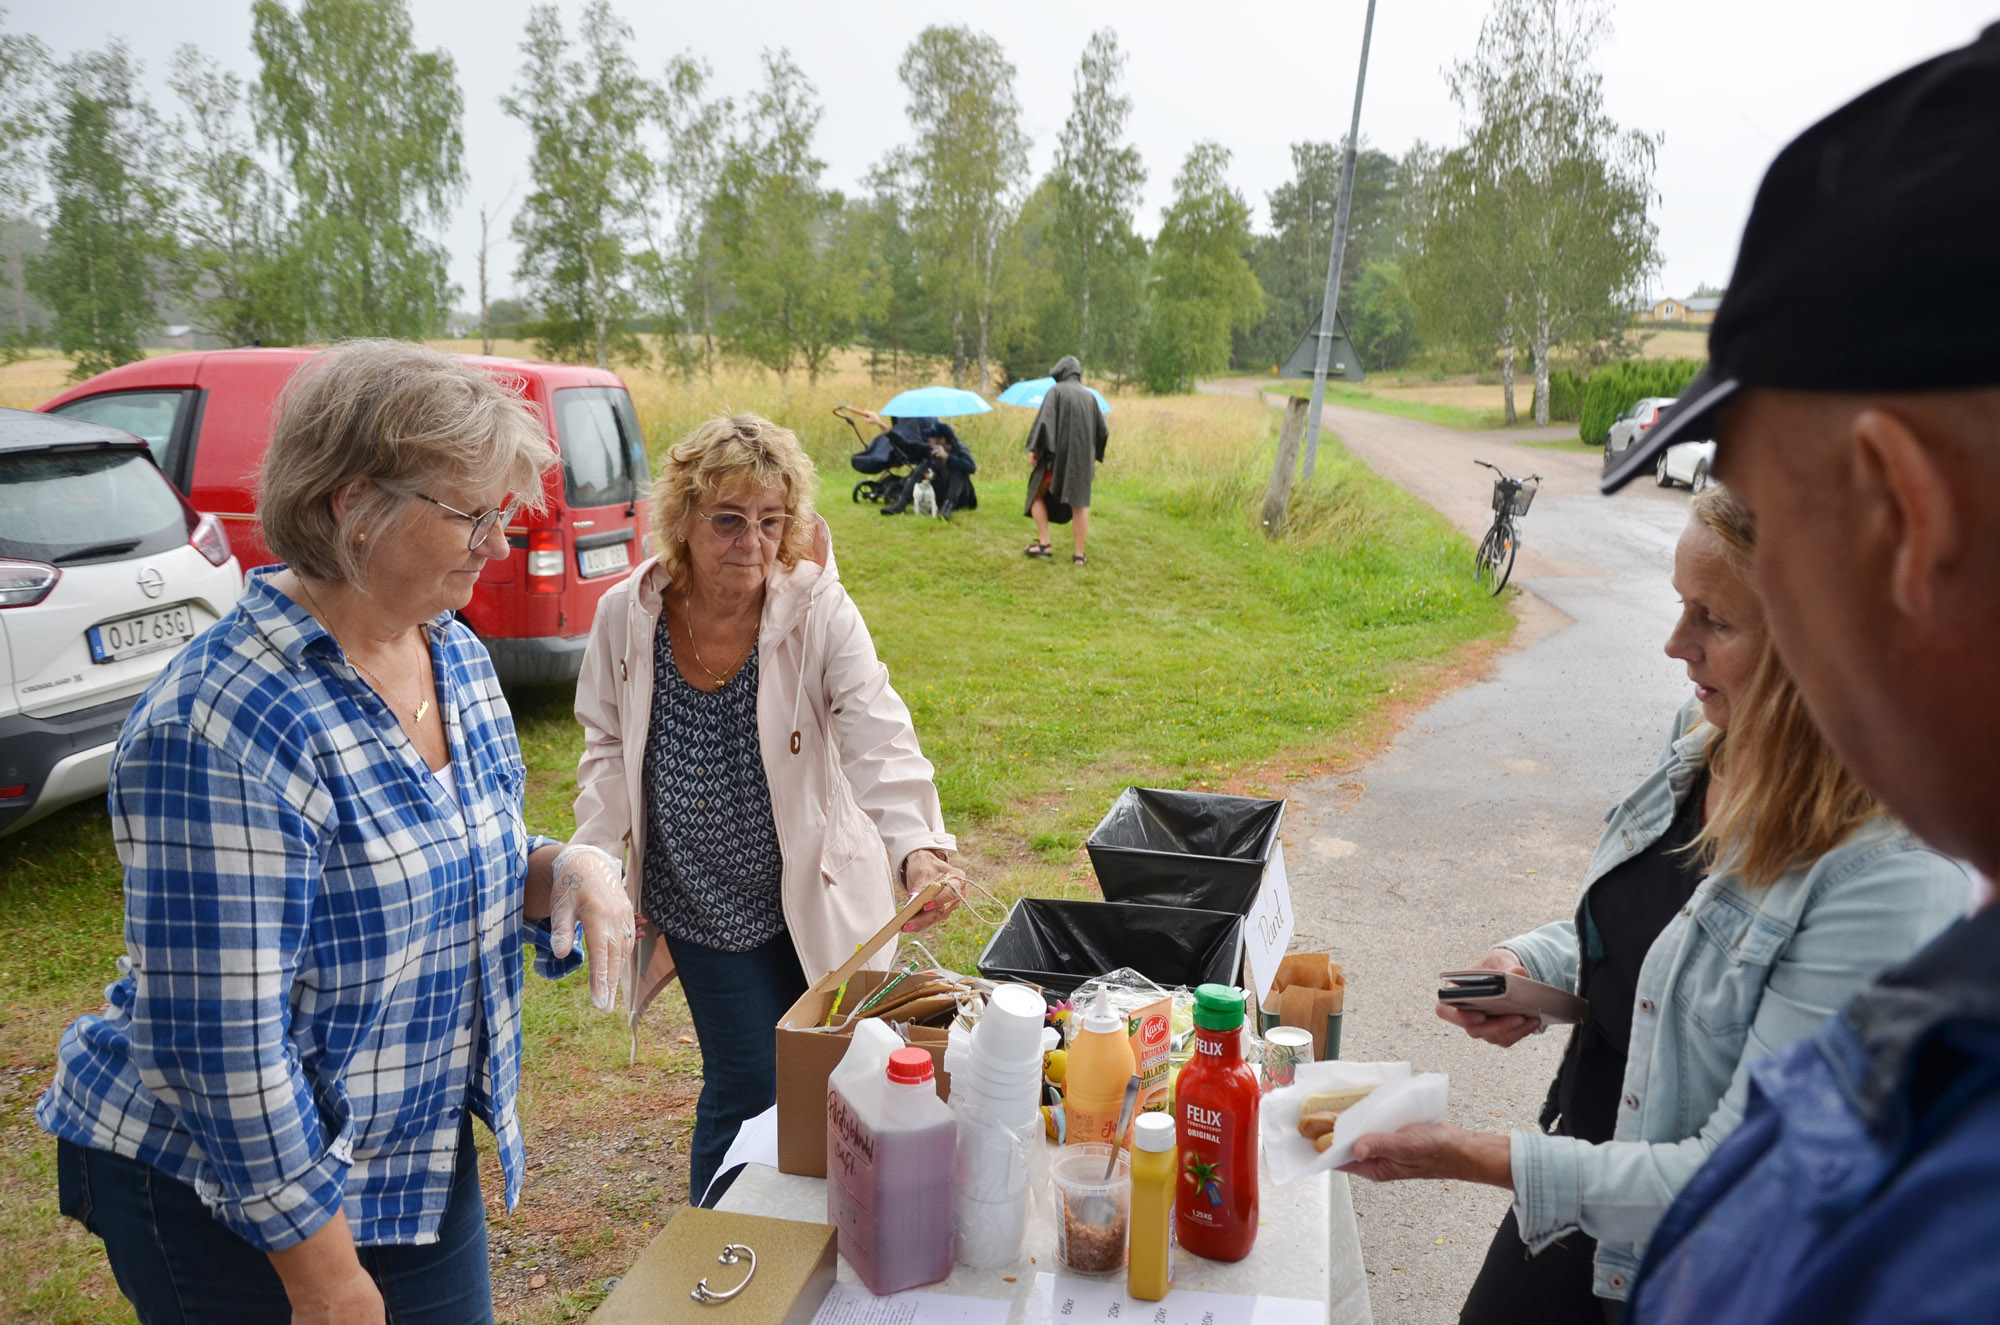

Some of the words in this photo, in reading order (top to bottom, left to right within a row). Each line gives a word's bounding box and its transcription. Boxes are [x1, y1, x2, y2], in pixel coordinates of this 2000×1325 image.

[108, 620, 149, 650] OJZ
[152, 611, 186, 639] 63G
[1258, 889, 1285, 955] Pant
[1144, 1018, 1166, 1043] Kavli
[1195, 1037, 1223, 1057] FELIX
[1186, 1103, 1222, 1127] FELIX
[1187, 1128, 1221, 1144] ORIGINAL
[1061, 1298, 1075, 1315] 60kr
[1108, 1301, 1121, 1319] 20kr
[1154, 1307, 1167, 1324] 20kr
